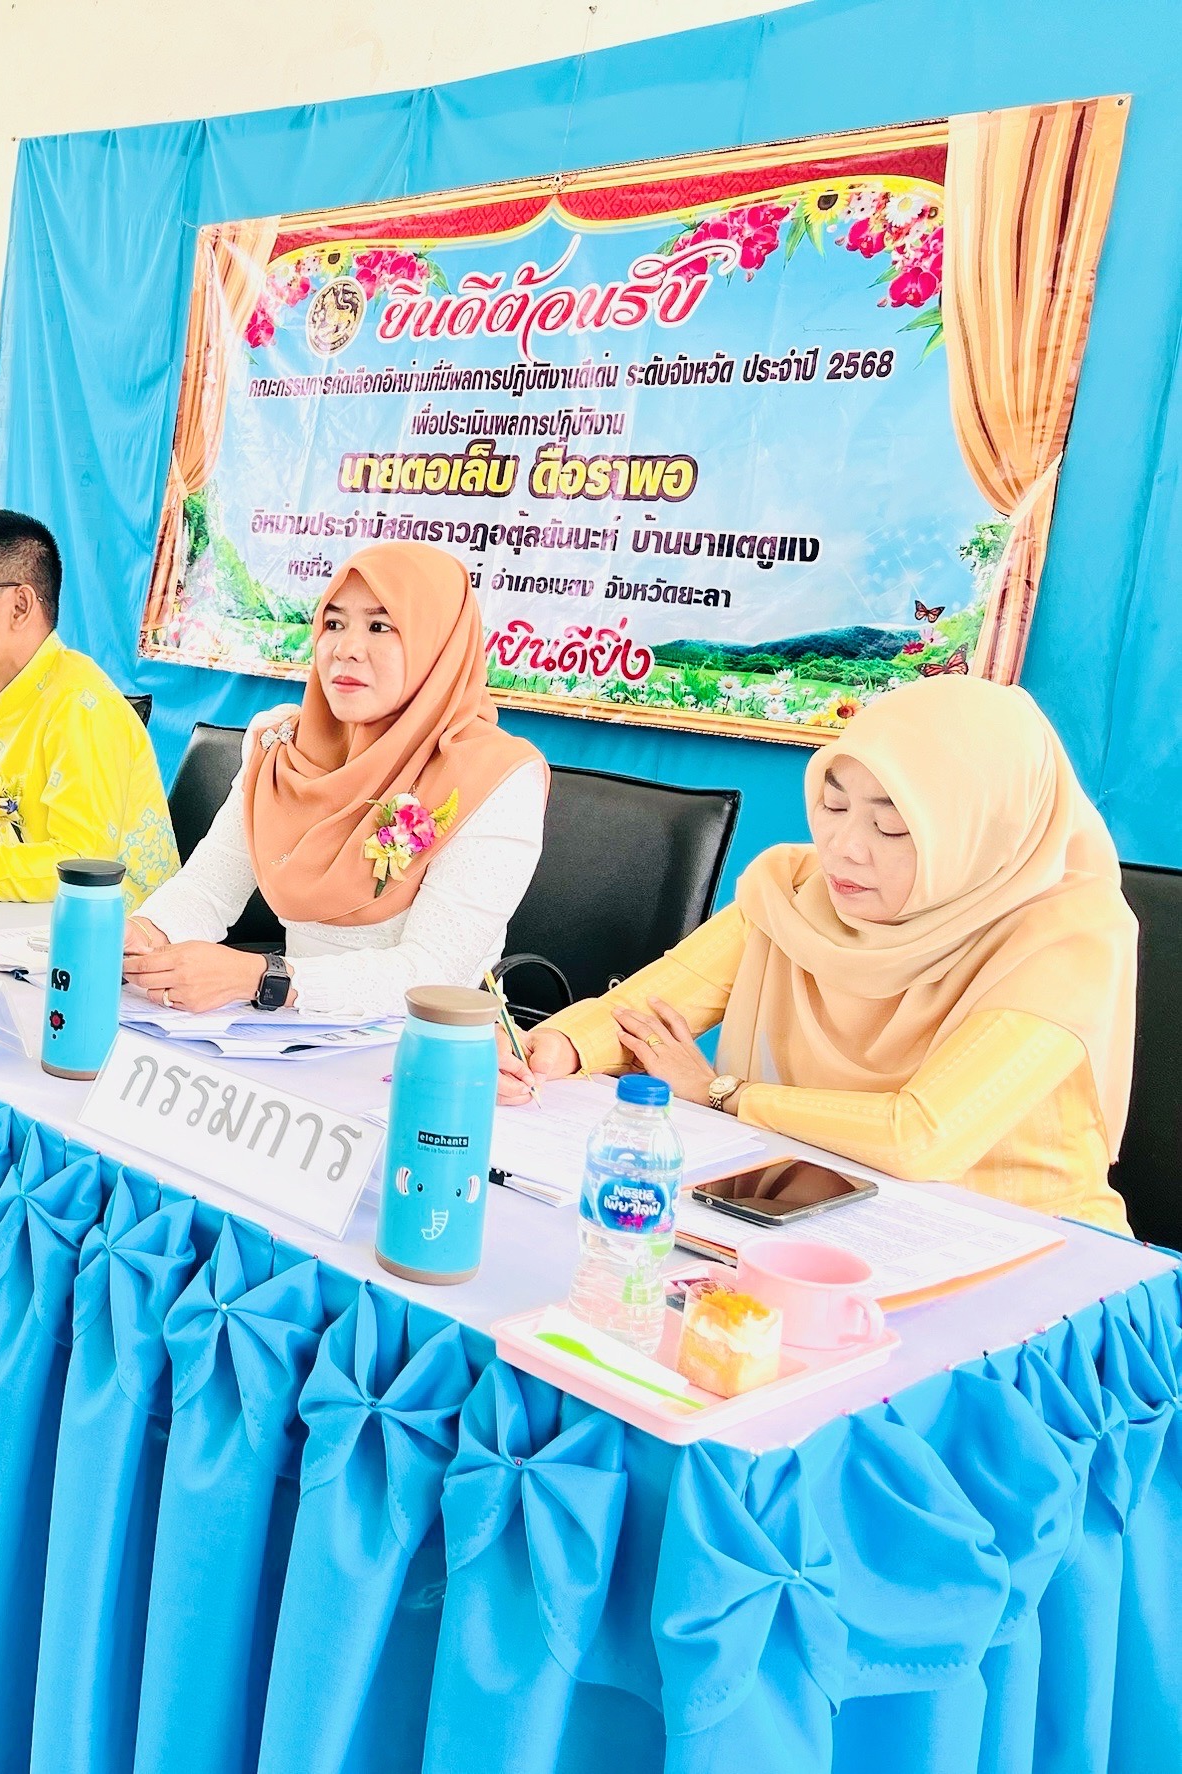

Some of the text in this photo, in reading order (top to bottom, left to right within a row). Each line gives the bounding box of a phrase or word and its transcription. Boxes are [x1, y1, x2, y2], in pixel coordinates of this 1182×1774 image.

[379, 236, 736, 360] ยินดีต้อนรับ
[626, 353, 732, 387] ระดับจังหวัด
[743, 347, 819, 382] ประจำปี
[826, 351, 894, 380] 2568
[339, 441, 697, 501] นายตอเล็บ ดือราพอ
[632, 514, 821, 569] บ้านบาแตตูแง
[492, 568, 594, 597] อำเภอเบตง
[604, 575, 733, 608] จังหวัดยะลา
[119, 1054, 363, 1182] กรรมการ
[419, 1133, 468, 1146] elephants
